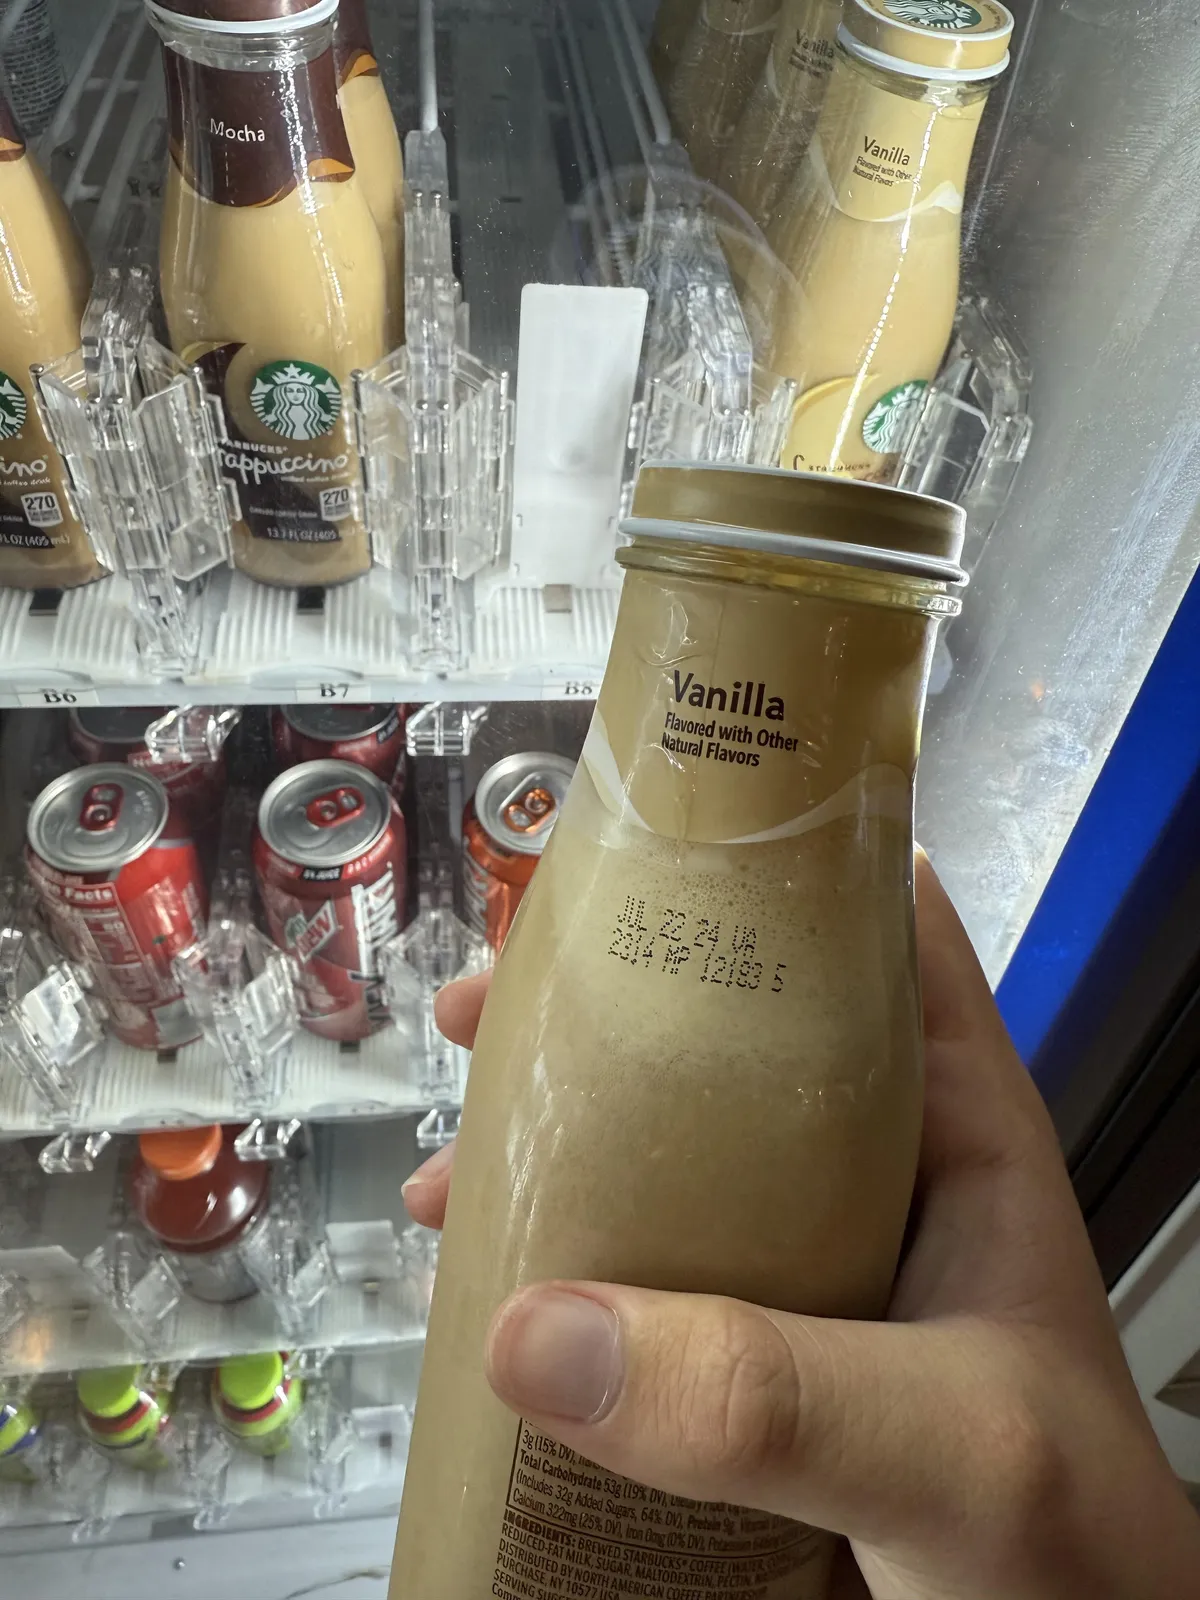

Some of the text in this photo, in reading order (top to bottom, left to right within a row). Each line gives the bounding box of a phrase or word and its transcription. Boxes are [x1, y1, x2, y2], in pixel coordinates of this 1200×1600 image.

[210, 118, 265, 142] Mocha
[864, 136, 910, 165] Vanilla
[853, 165, 894, 187] Natural Flavors
[856, 156, 912, 180] Flavored with Other
[218, 447, 349, 485] rappuccino
[25, 495, 56, 510] 270
[323, 488, 349, 506] 270
[43, 689, 77, 703] B6
[320, 683, 349, 698] B7
[565, 681, 593, 695] B8
[674, 670, 785, 721] Vanilla
[664, 711, 799, 752] Flavored with Other
[661, 732, 760, 767] Natural Flavors
[64, 887, 113, 900] Facts
[693, 918, 721, 951] 24
[522, 1429, 535, 1450] 3g
[534, 1435, 557, 1457] (15%
[520, 1449, 541, 1470] Total
[542, 1459, 602, 1487] Carbohydrate
[603, 1477, 622, 1499] 53g
[623, 1482, 648, 1500] (19%
[516, 1468, 554, 1497] (Includes
[555, 1485, 574, 1507] 32g
[575, 1492, 604, 1512] Added
[605, 1499, 638, 1523] Sugars,
[641, 1507, 664, 1525] 64%
[513, 1488, 546, 1515] Calcium
[546, 1503, 578, 1527] 322mg
[579, 1512, 603, 1532] (25%
[626, 1524, 643, 1540] Iron
[502, 1523, 565, 1558] REDUCED-FAT
[566, 1549, 594, 1569] MILK,
[595, 1558, 633, 1578] SUGAR,
[635, 1565, 714, 1587] MALTODEXTRIN,
[503, 1509, 576, 1548] INGREDIENTS:
[578, 1537, 620, 1557] BREWED
[689, 1558, 729, 1572] COFFEE
[493, 1568, 536, 1599] SERVING
[496, 1553, 548, 1587] PURCHASE,
[550, 1576, 564, 1590] NY
[566, 1580, 598, 1599] 10577
[600, 1586, 621, 1600] USA
[499, 1538, 559, 1574] DISTRIBUTED
[560, 1564, 575, 1578] BY
[575, 1568, 609, 1589] NORTH
[611, 1579, 664, 1599] AMERICAN
